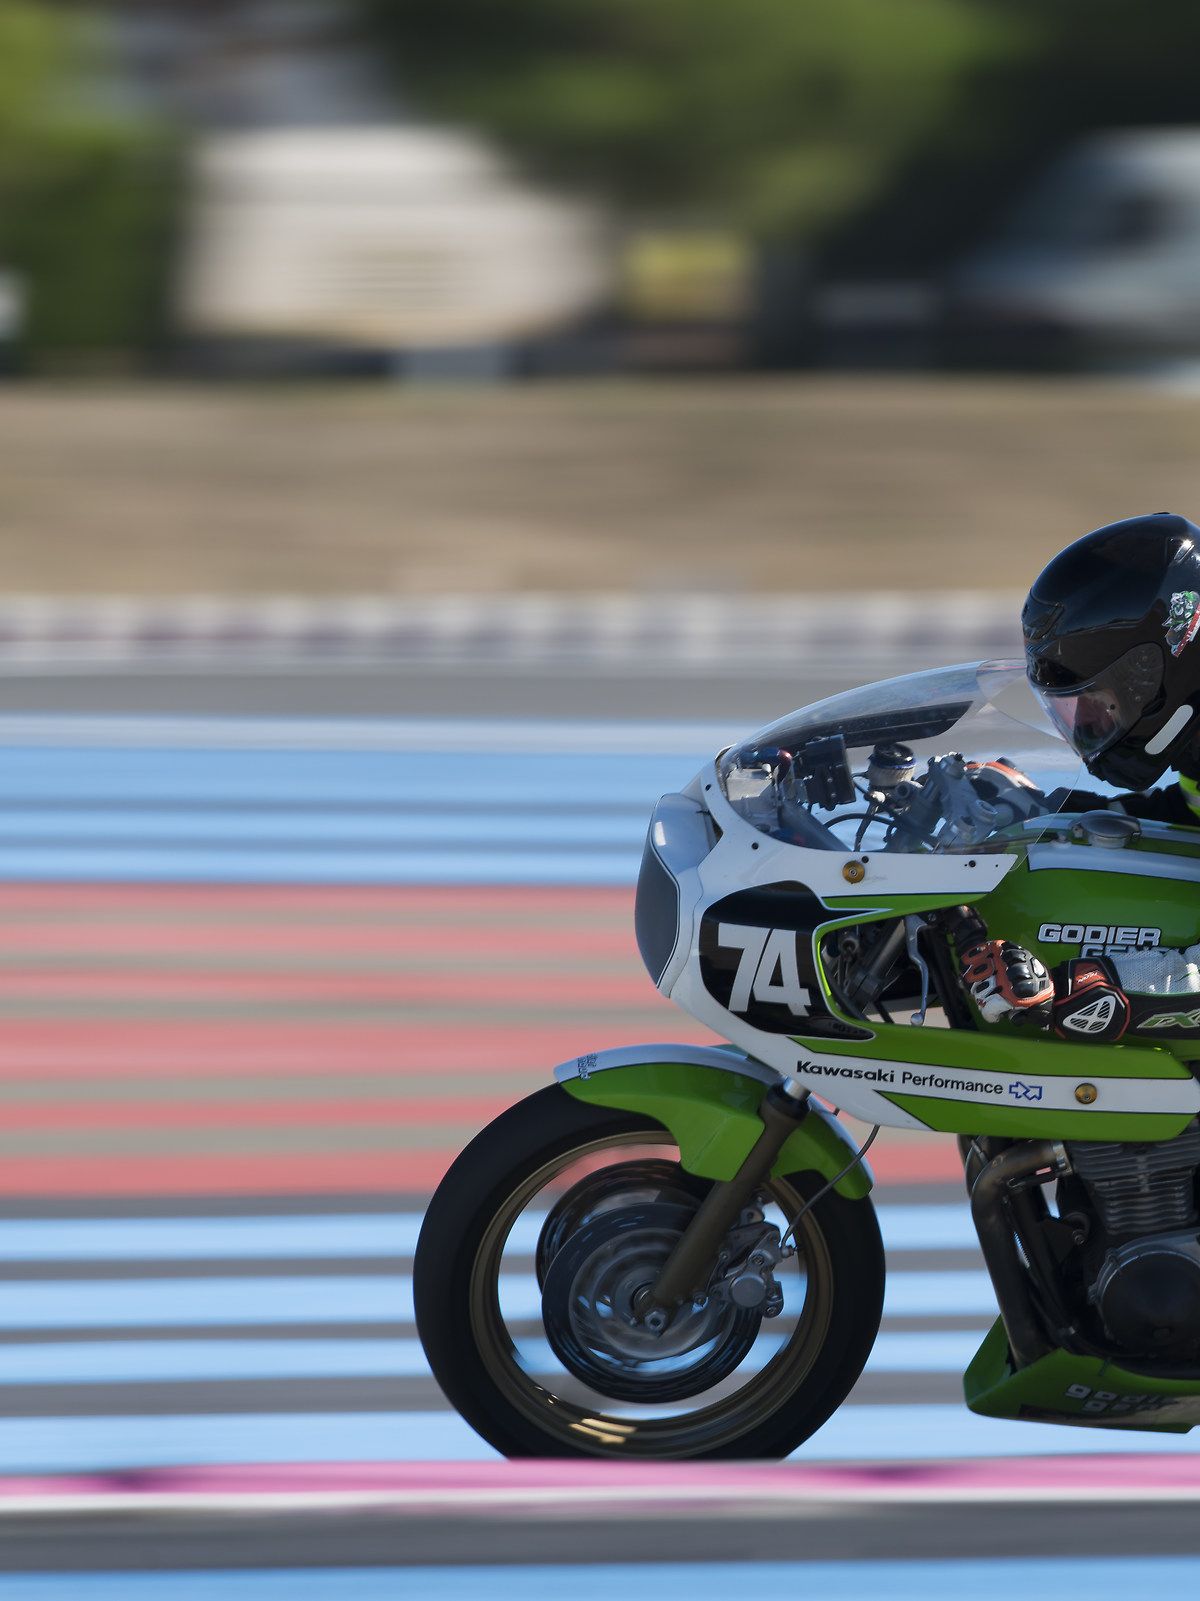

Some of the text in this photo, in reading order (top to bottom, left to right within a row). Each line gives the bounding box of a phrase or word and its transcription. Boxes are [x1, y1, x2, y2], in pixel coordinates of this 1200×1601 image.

[1038, 923, 1162, 946] GODIER
[718, 922, 812, 1017] 74
[796, 1060, 1003, 1094] Kawasaki Performance
